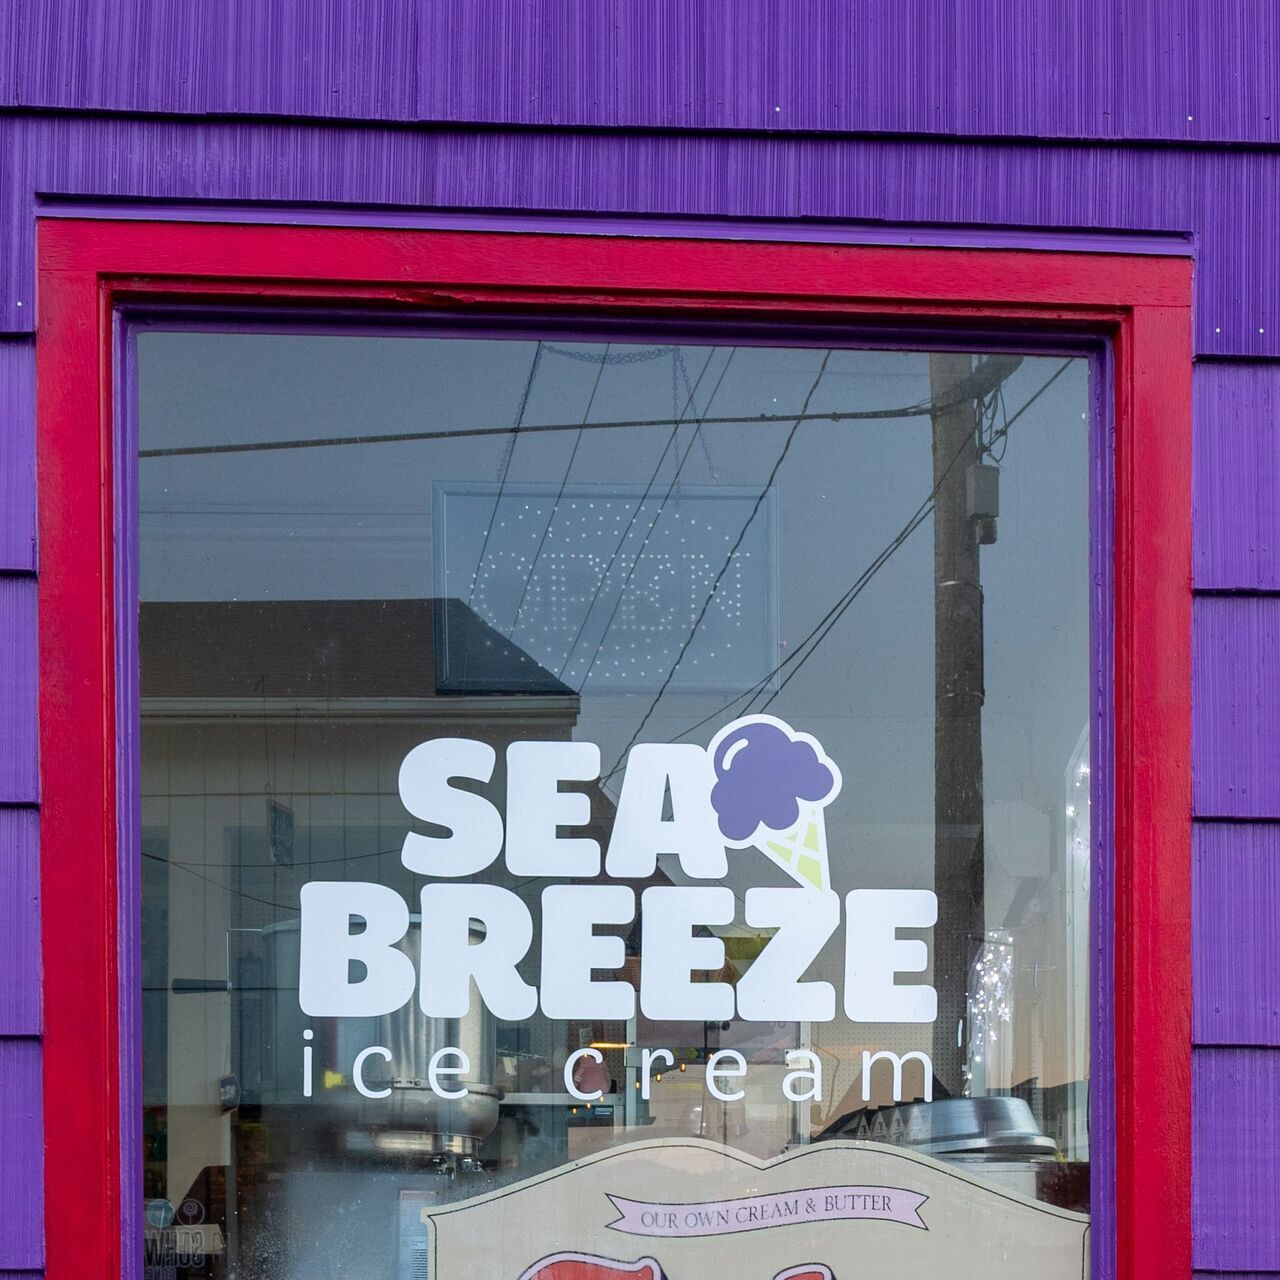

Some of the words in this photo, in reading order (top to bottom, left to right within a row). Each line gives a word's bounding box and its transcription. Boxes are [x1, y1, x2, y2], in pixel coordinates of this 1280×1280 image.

[471, 551, 750, 631] OPEN
[398, 738, 729, 878] SEA
[299, 881, 939, 1022] BREEZE
[301, 1030, 471, 1102] ice
[563, 1044, 935, 1102] cream
[640, 1211, 679, 1229] OUR
[684, 1208, 731, 1229] OWN
[735, 1199, 799, 1225] CREAM
[805, 1197, 817, 1214] &
[824, 1194, 893, 1213] BUTTER
